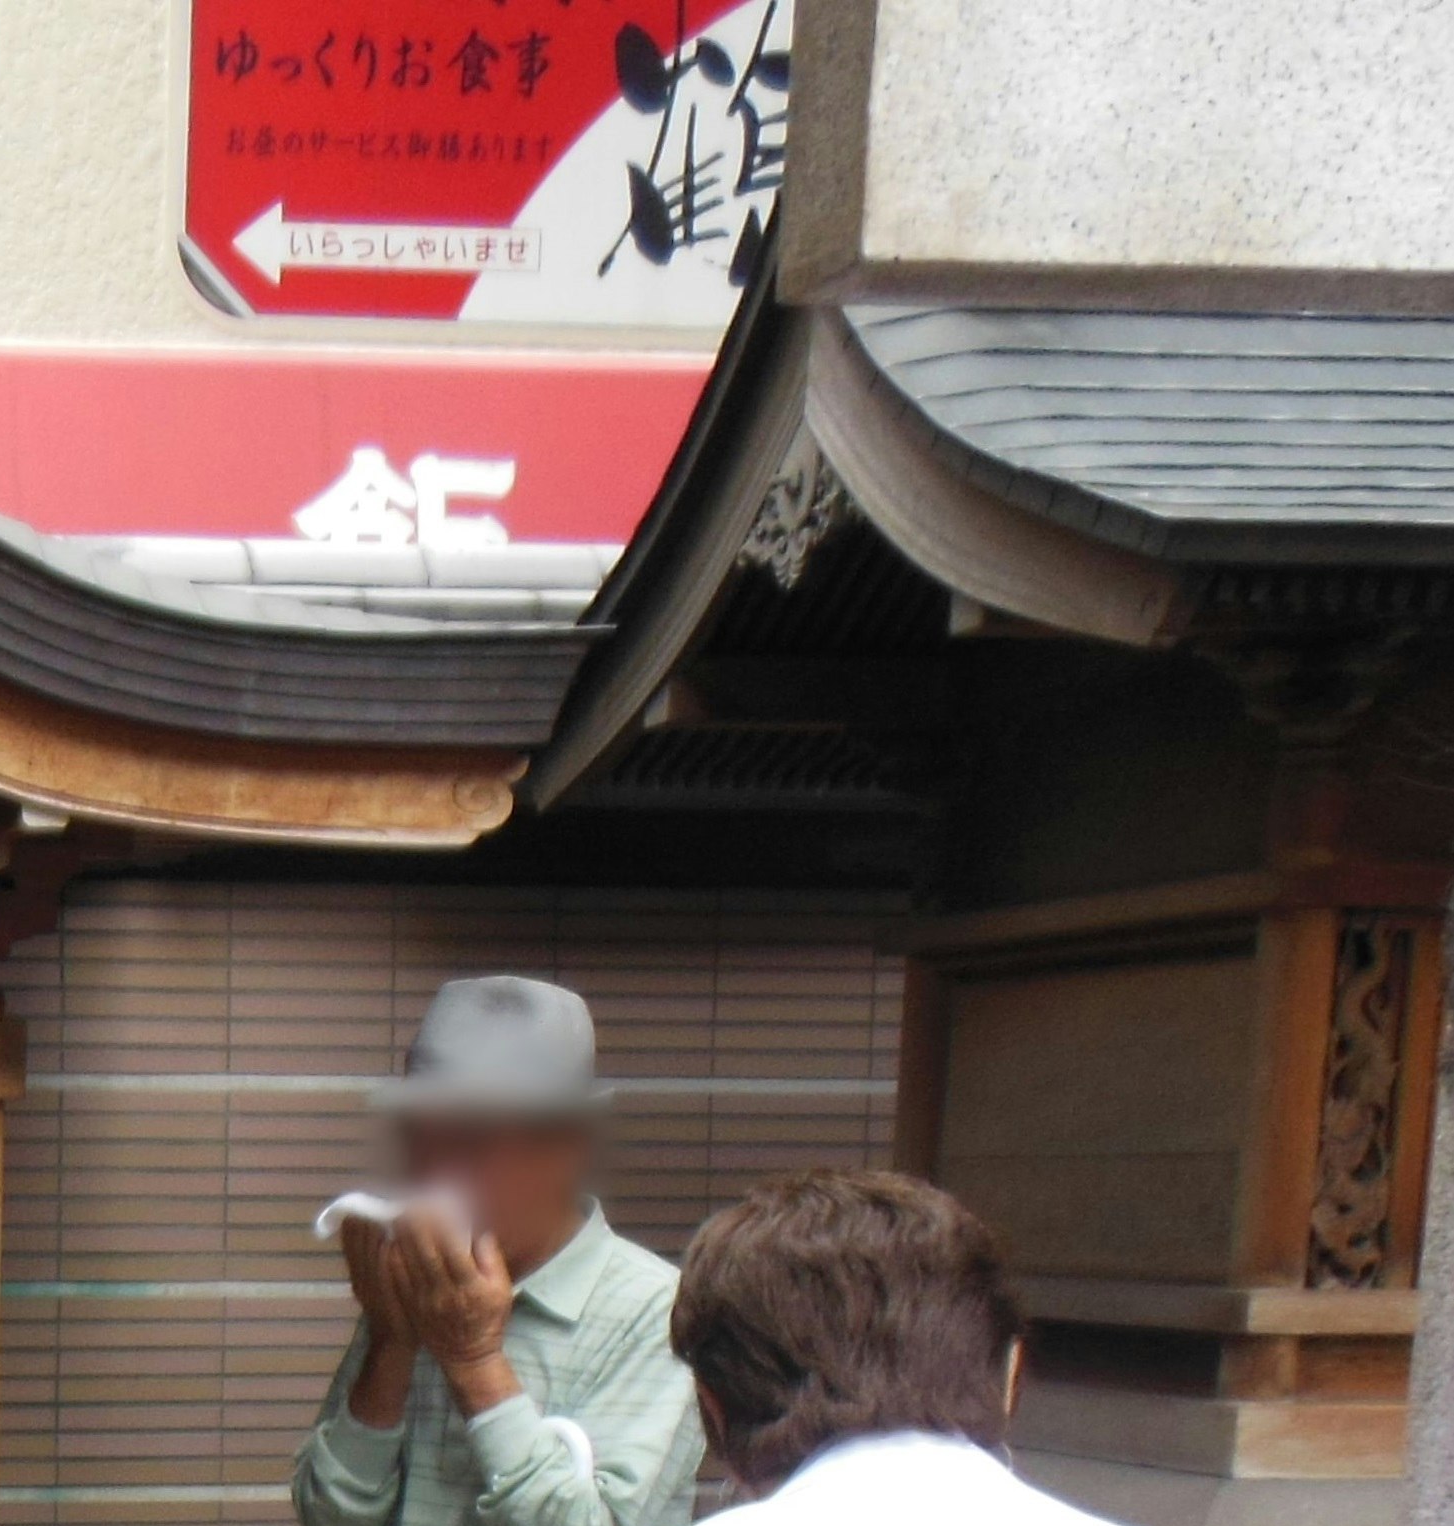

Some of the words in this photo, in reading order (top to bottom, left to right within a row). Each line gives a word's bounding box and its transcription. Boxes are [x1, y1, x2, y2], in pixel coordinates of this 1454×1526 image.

[215, 28, 553, 98] ゆっくりお食事
[288, 229, 529, 264] いらっしゃいませ
